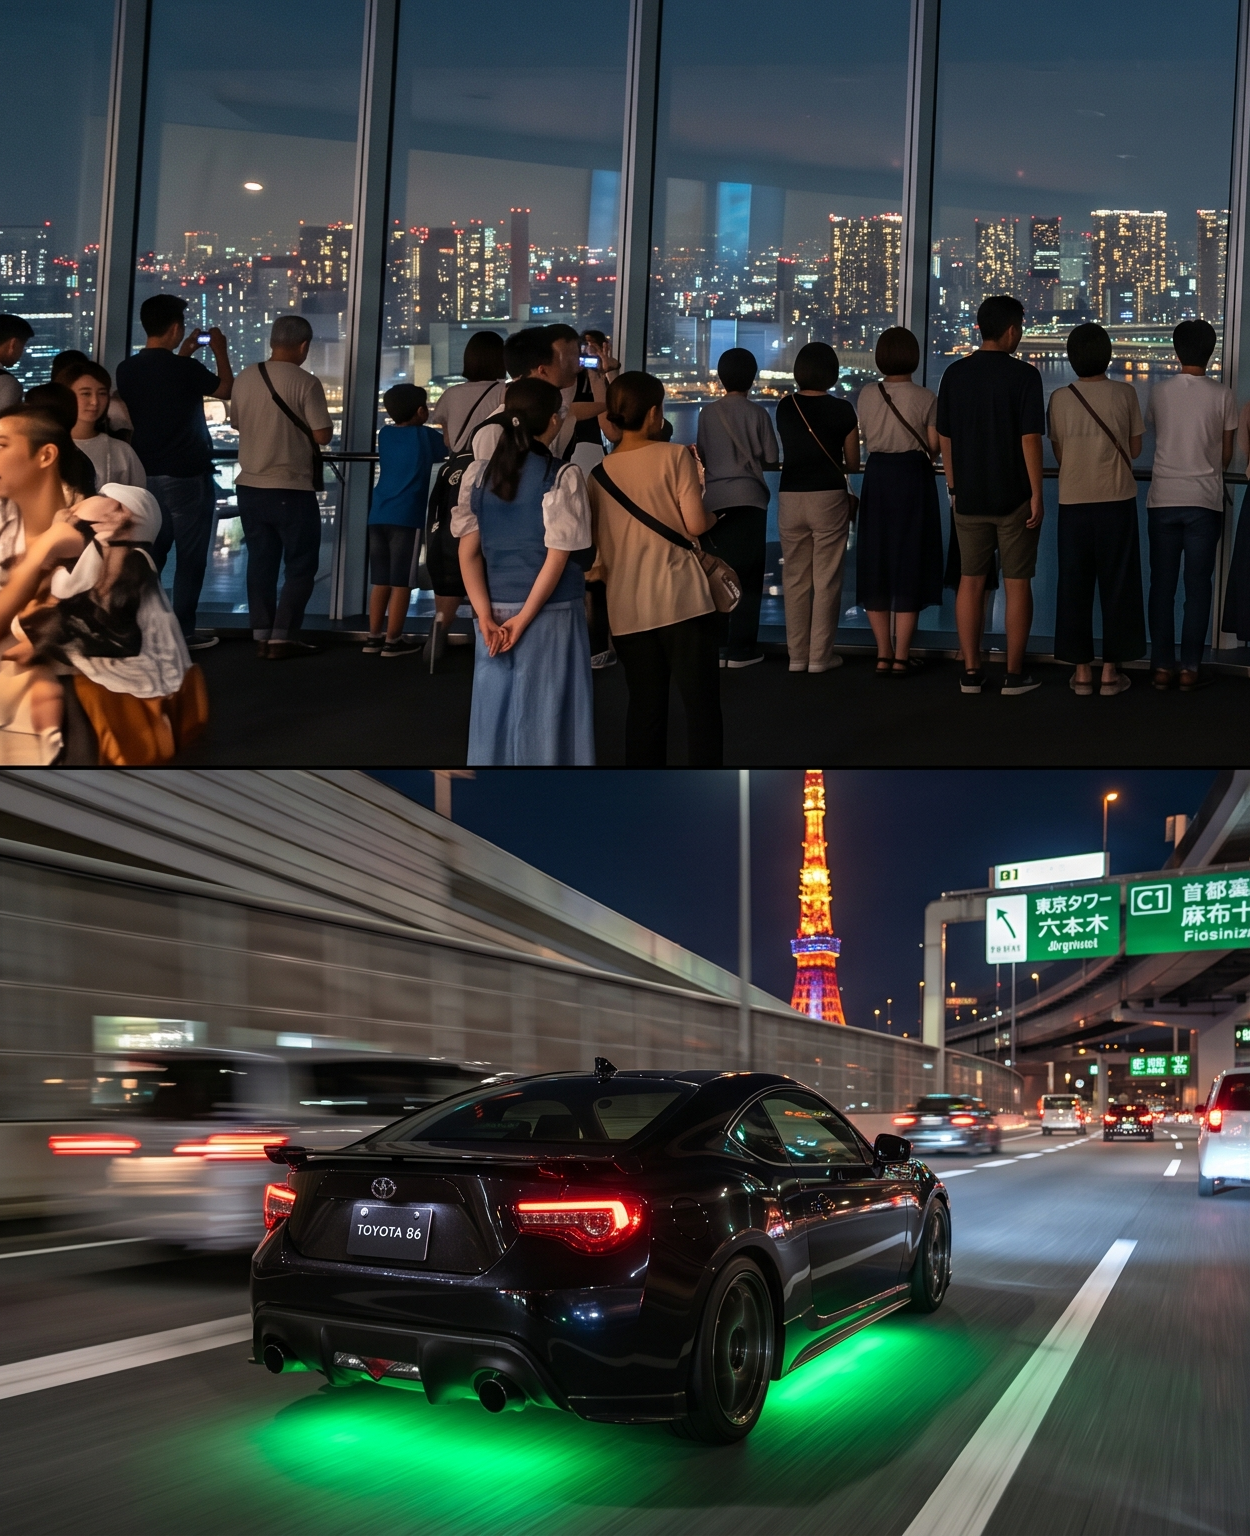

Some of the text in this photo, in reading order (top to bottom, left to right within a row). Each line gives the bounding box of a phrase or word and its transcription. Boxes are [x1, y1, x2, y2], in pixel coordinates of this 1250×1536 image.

[1035, 893, 1112, 915] 東京タワー
[1137, 890, 1164, 910] C1
[1038, 914, 1109, 938] 六本木
[358, 1224, 421, 1240] TOYOTA 86
